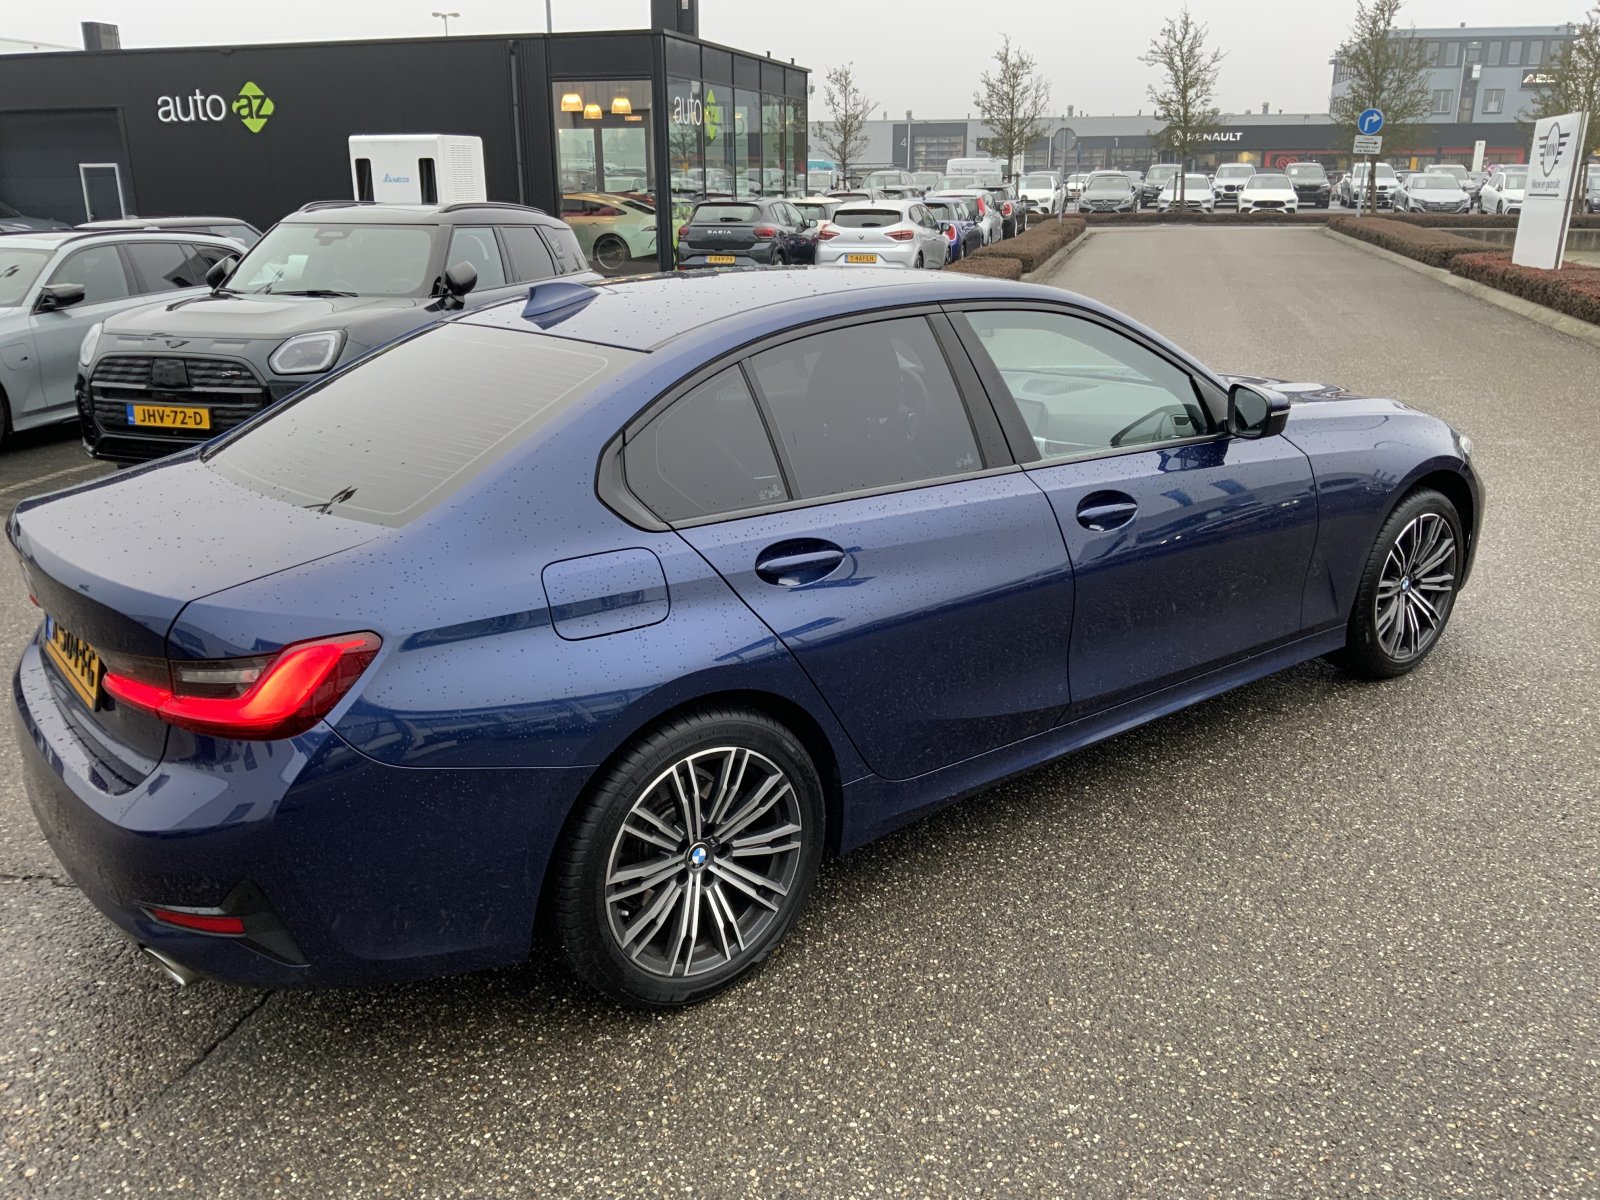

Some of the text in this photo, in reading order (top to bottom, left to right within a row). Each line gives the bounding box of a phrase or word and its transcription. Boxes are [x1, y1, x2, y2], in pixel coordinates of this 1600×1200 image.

[157, 88, 270, 122] auto az
[673, 91, 702, 126] auto
[900, 137, 907, 147] 4
[140, 408, 203, 425] JHV-72-D
